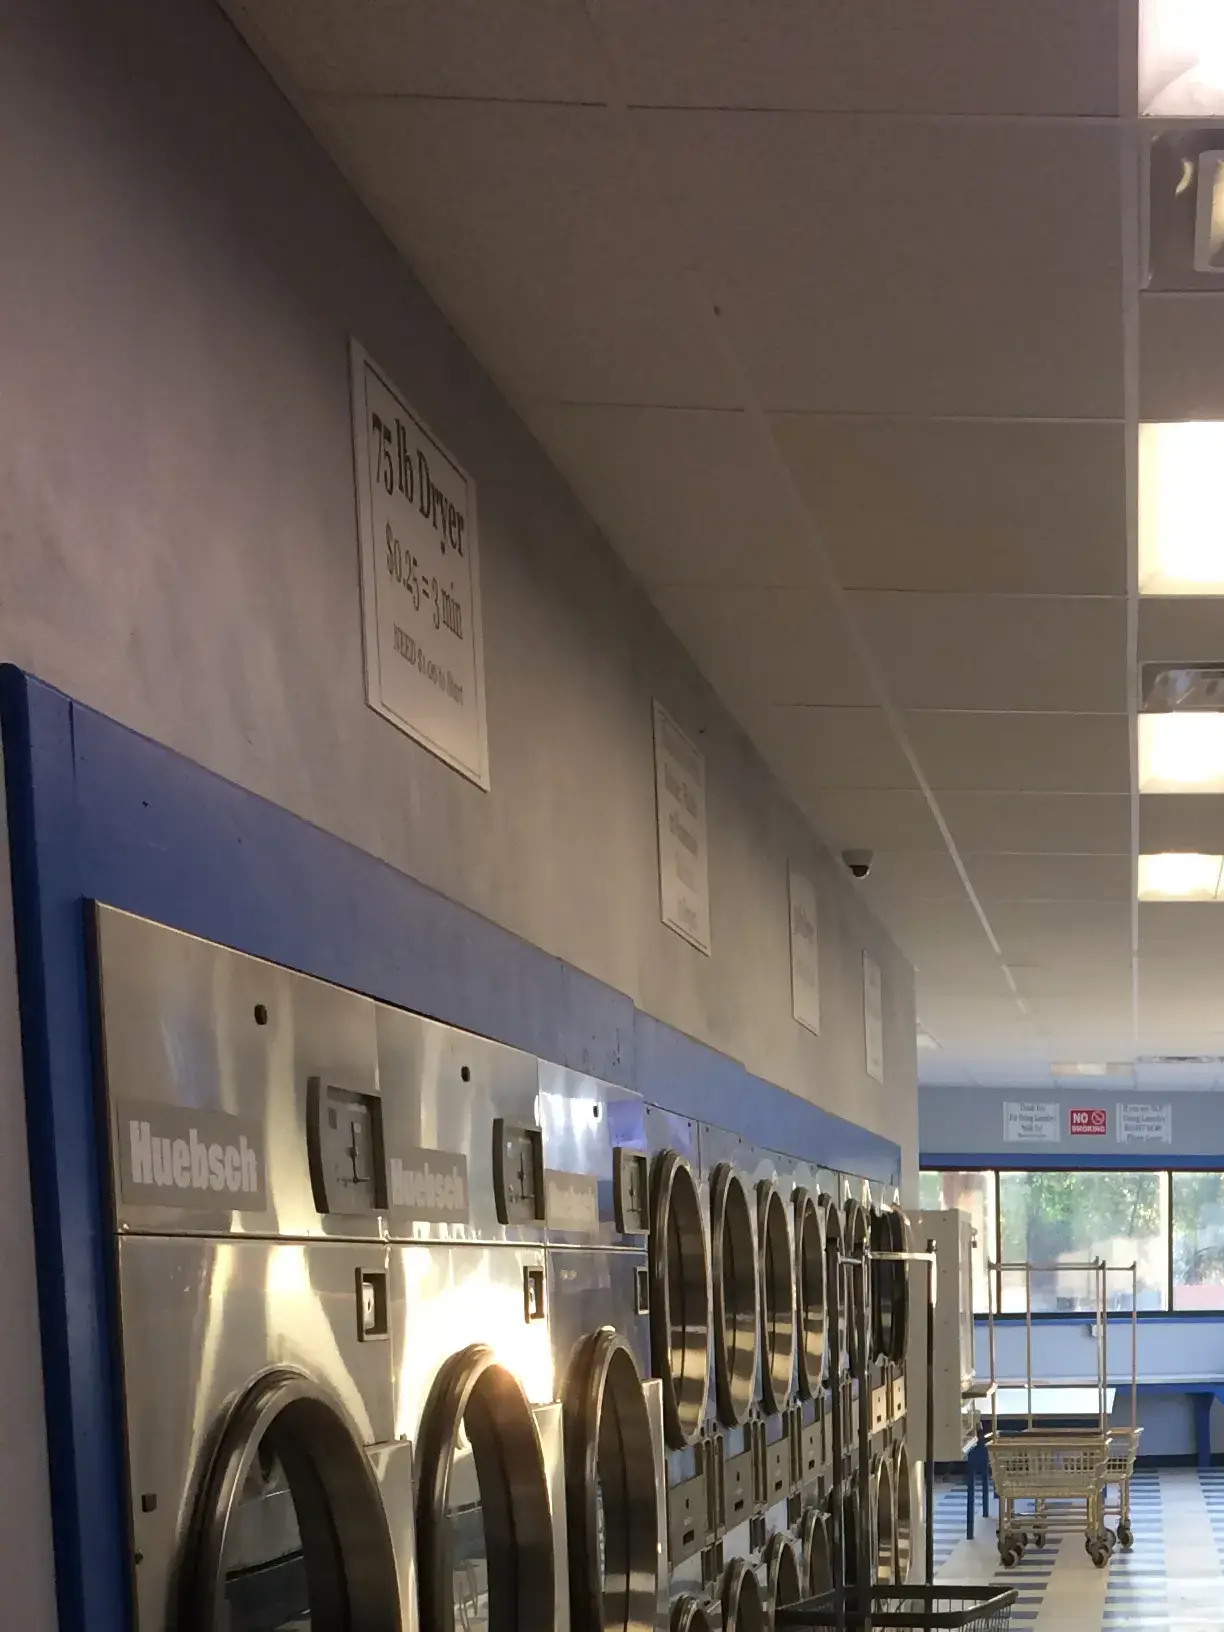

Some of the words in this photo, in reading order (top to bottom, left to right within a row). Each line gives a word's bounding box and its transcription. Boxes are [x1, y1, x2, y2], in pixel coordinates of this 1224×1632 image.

[372, 412, 394, 496] 75
[394, 417, 414, 503] lb
[416, 446, 465, 558] Dryer
[384, 520, 420, 612] $0.25
[421, 574, 430, 600] =
[432, 575, 440, 630] 3
[441, 581, 464, 640] min
[393, 622, 417, 666] NEED
[1071, 1125, 1106, 1133] SMOKING
[1072, 1112, 1089, 1124] NO
[129, 1119, 258, 1192] Huebsch
[390, 1158, 465, 1211] Huebsch
